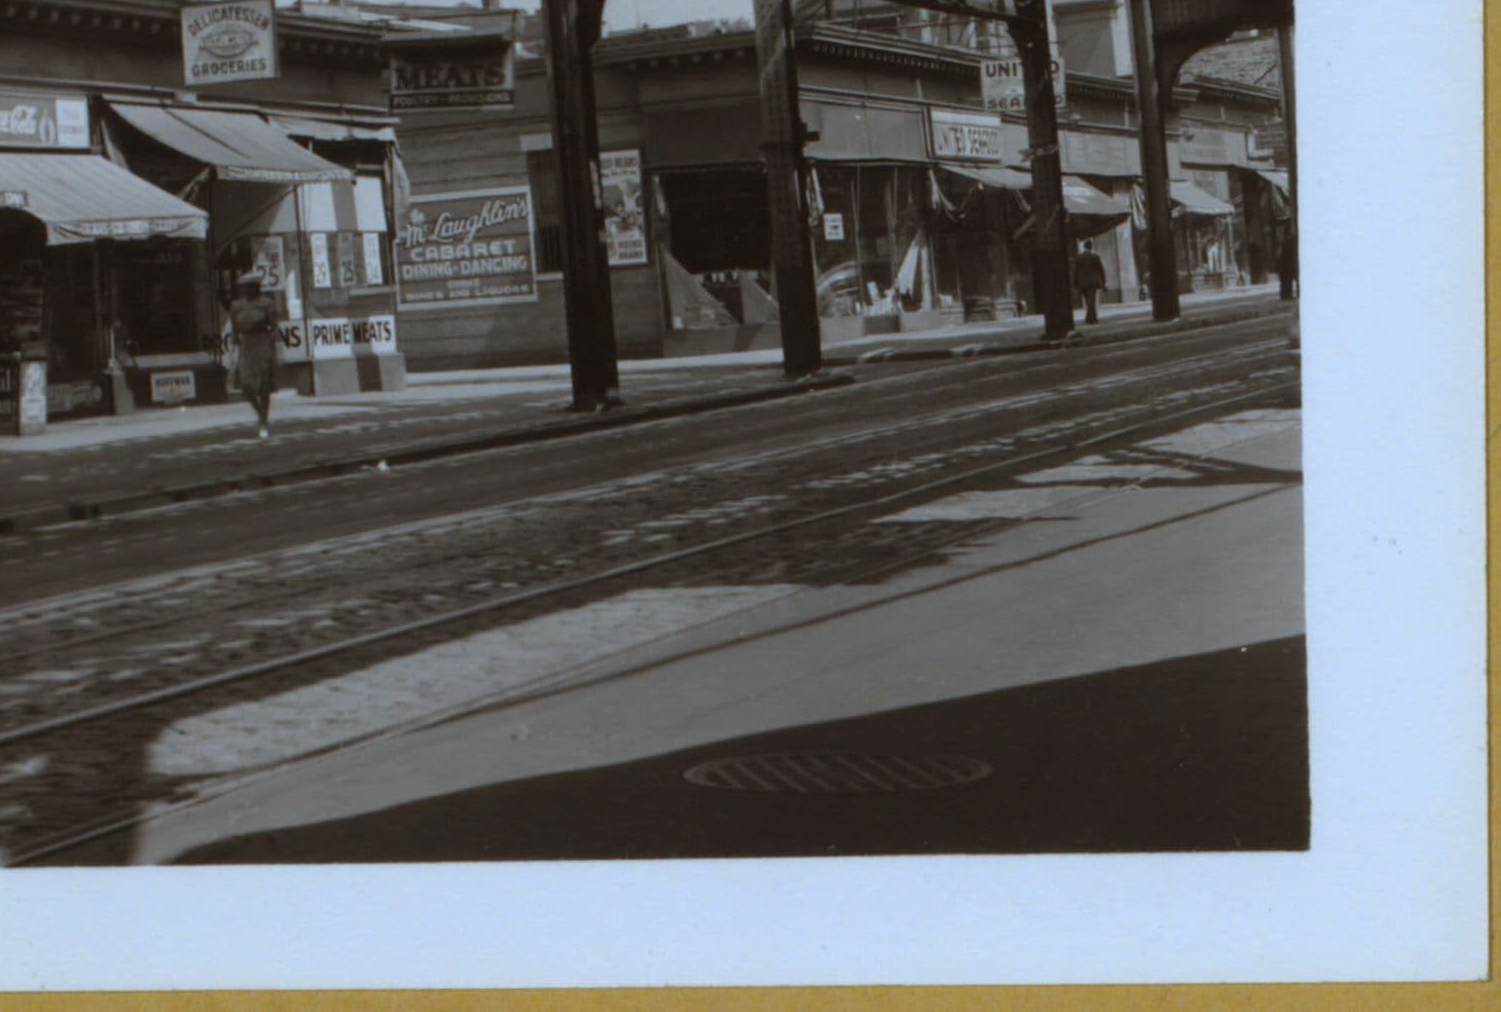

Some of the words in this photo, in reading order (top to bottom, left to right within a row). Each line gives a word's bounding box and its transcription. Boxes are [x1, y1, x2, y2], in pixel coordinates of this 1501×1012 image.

[191, 58, 268, 78] GROCERIES
[396, 61, 504, 91] MEATS
[409, 238, 517, 262] CABARET
[313, 323, 350, 345] PRIME
[353, 320, 392, 343] MEATS
